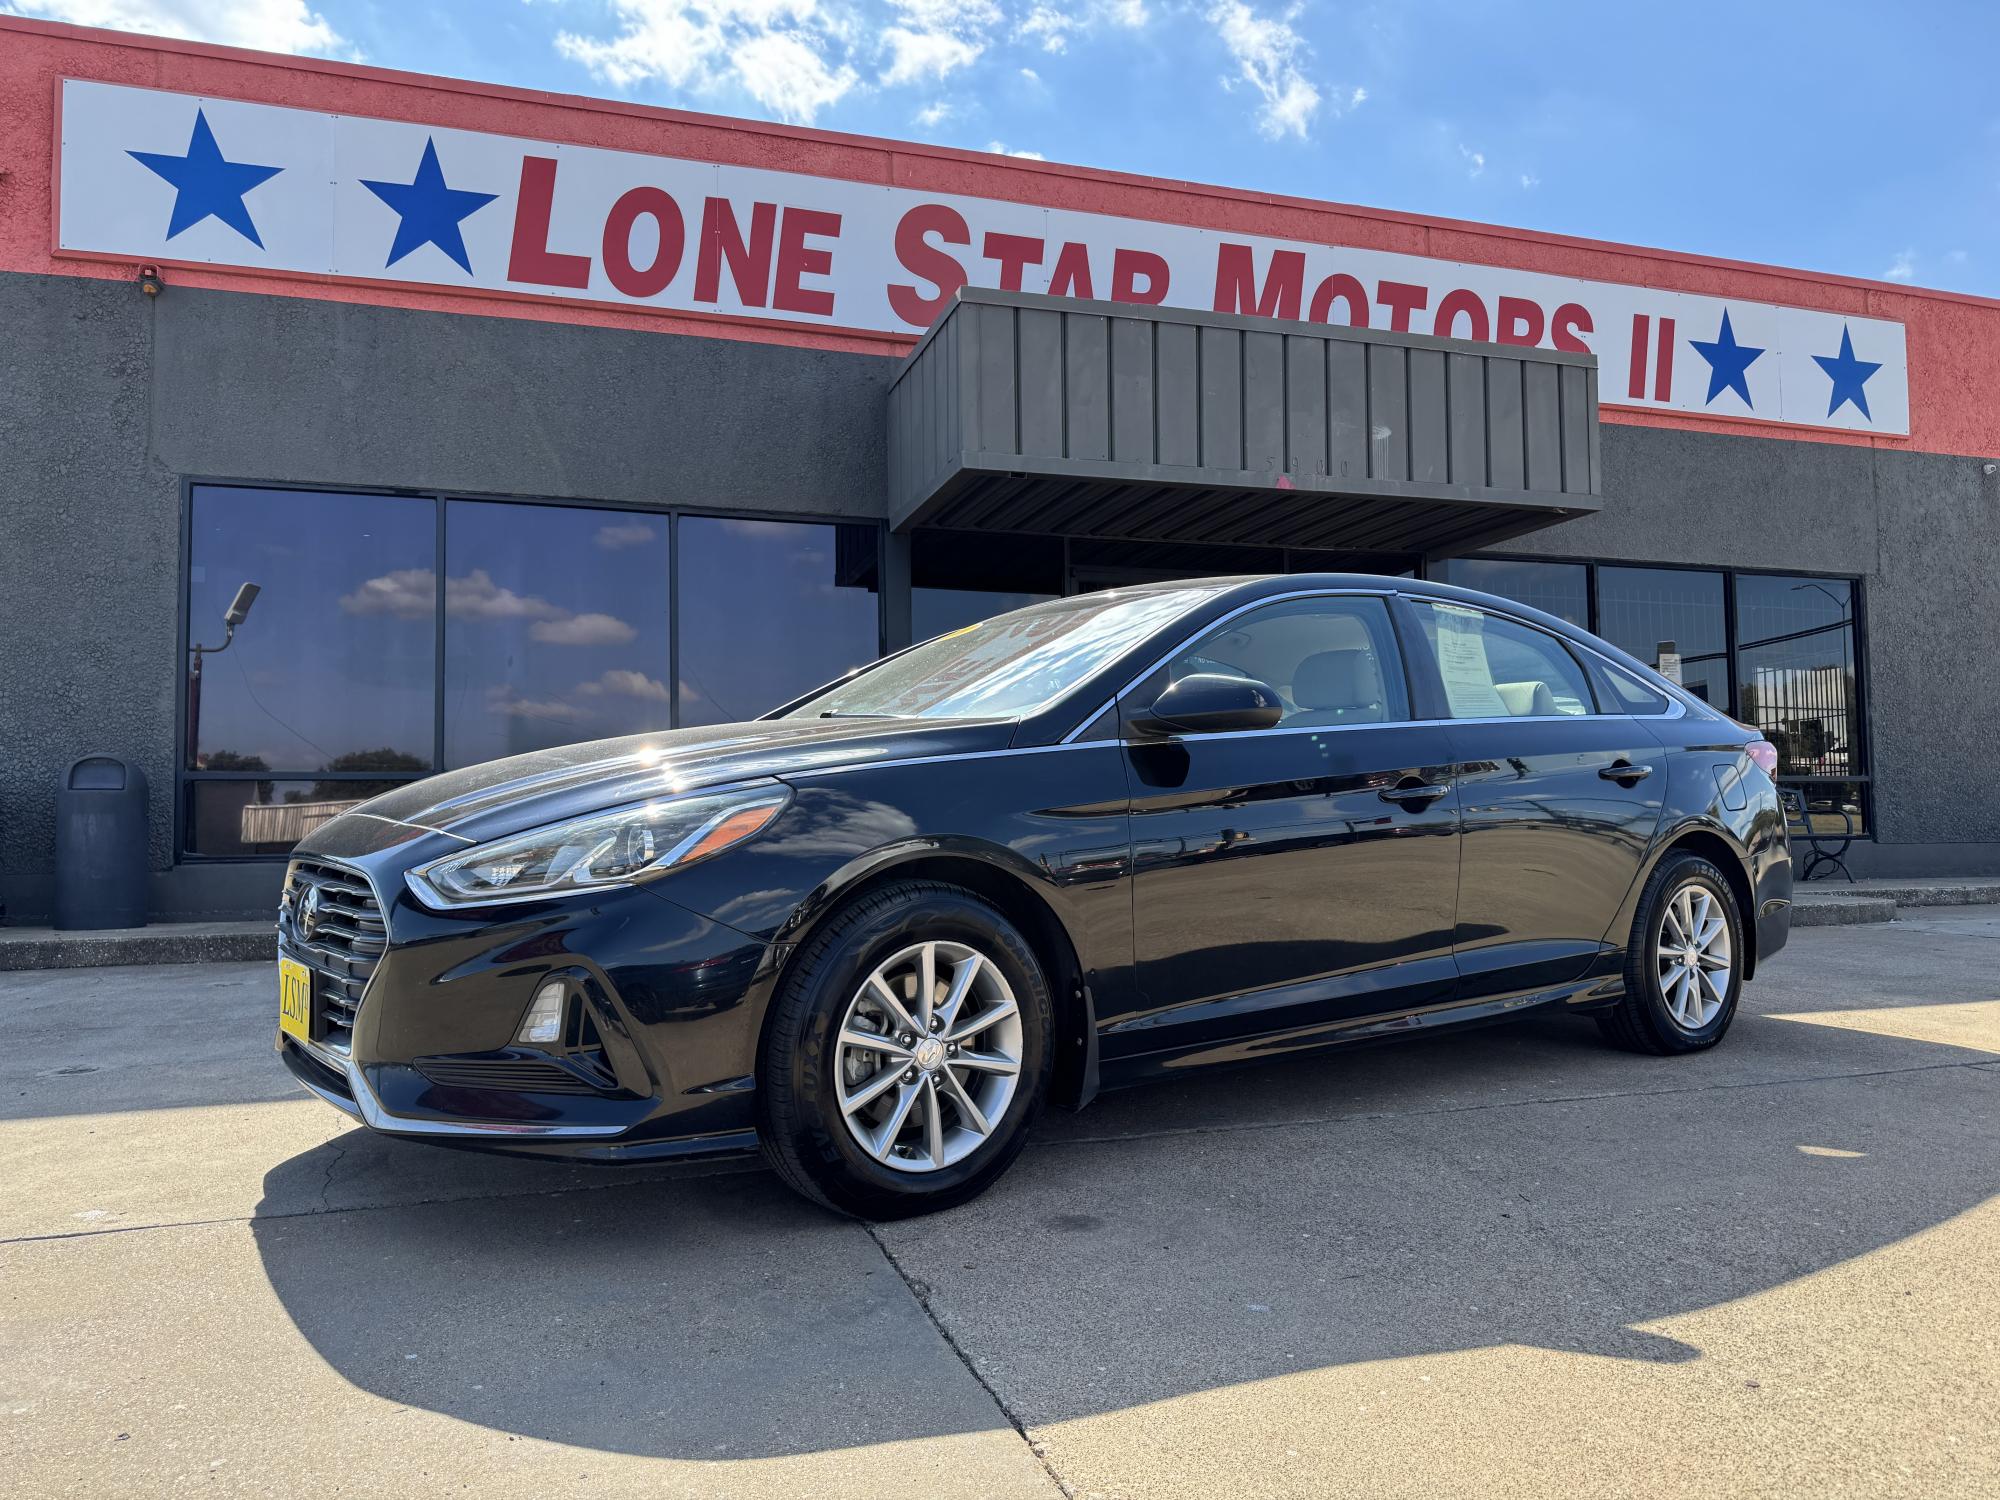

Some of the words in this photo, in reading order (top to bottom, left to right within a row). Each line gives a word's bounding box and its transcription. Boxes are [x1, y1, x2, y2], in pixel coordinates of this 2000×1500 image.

[507, 155, 842, 316] LONE
[887, 203, 1170, 328] STAR
[1628, 313, 1676, 403] II
